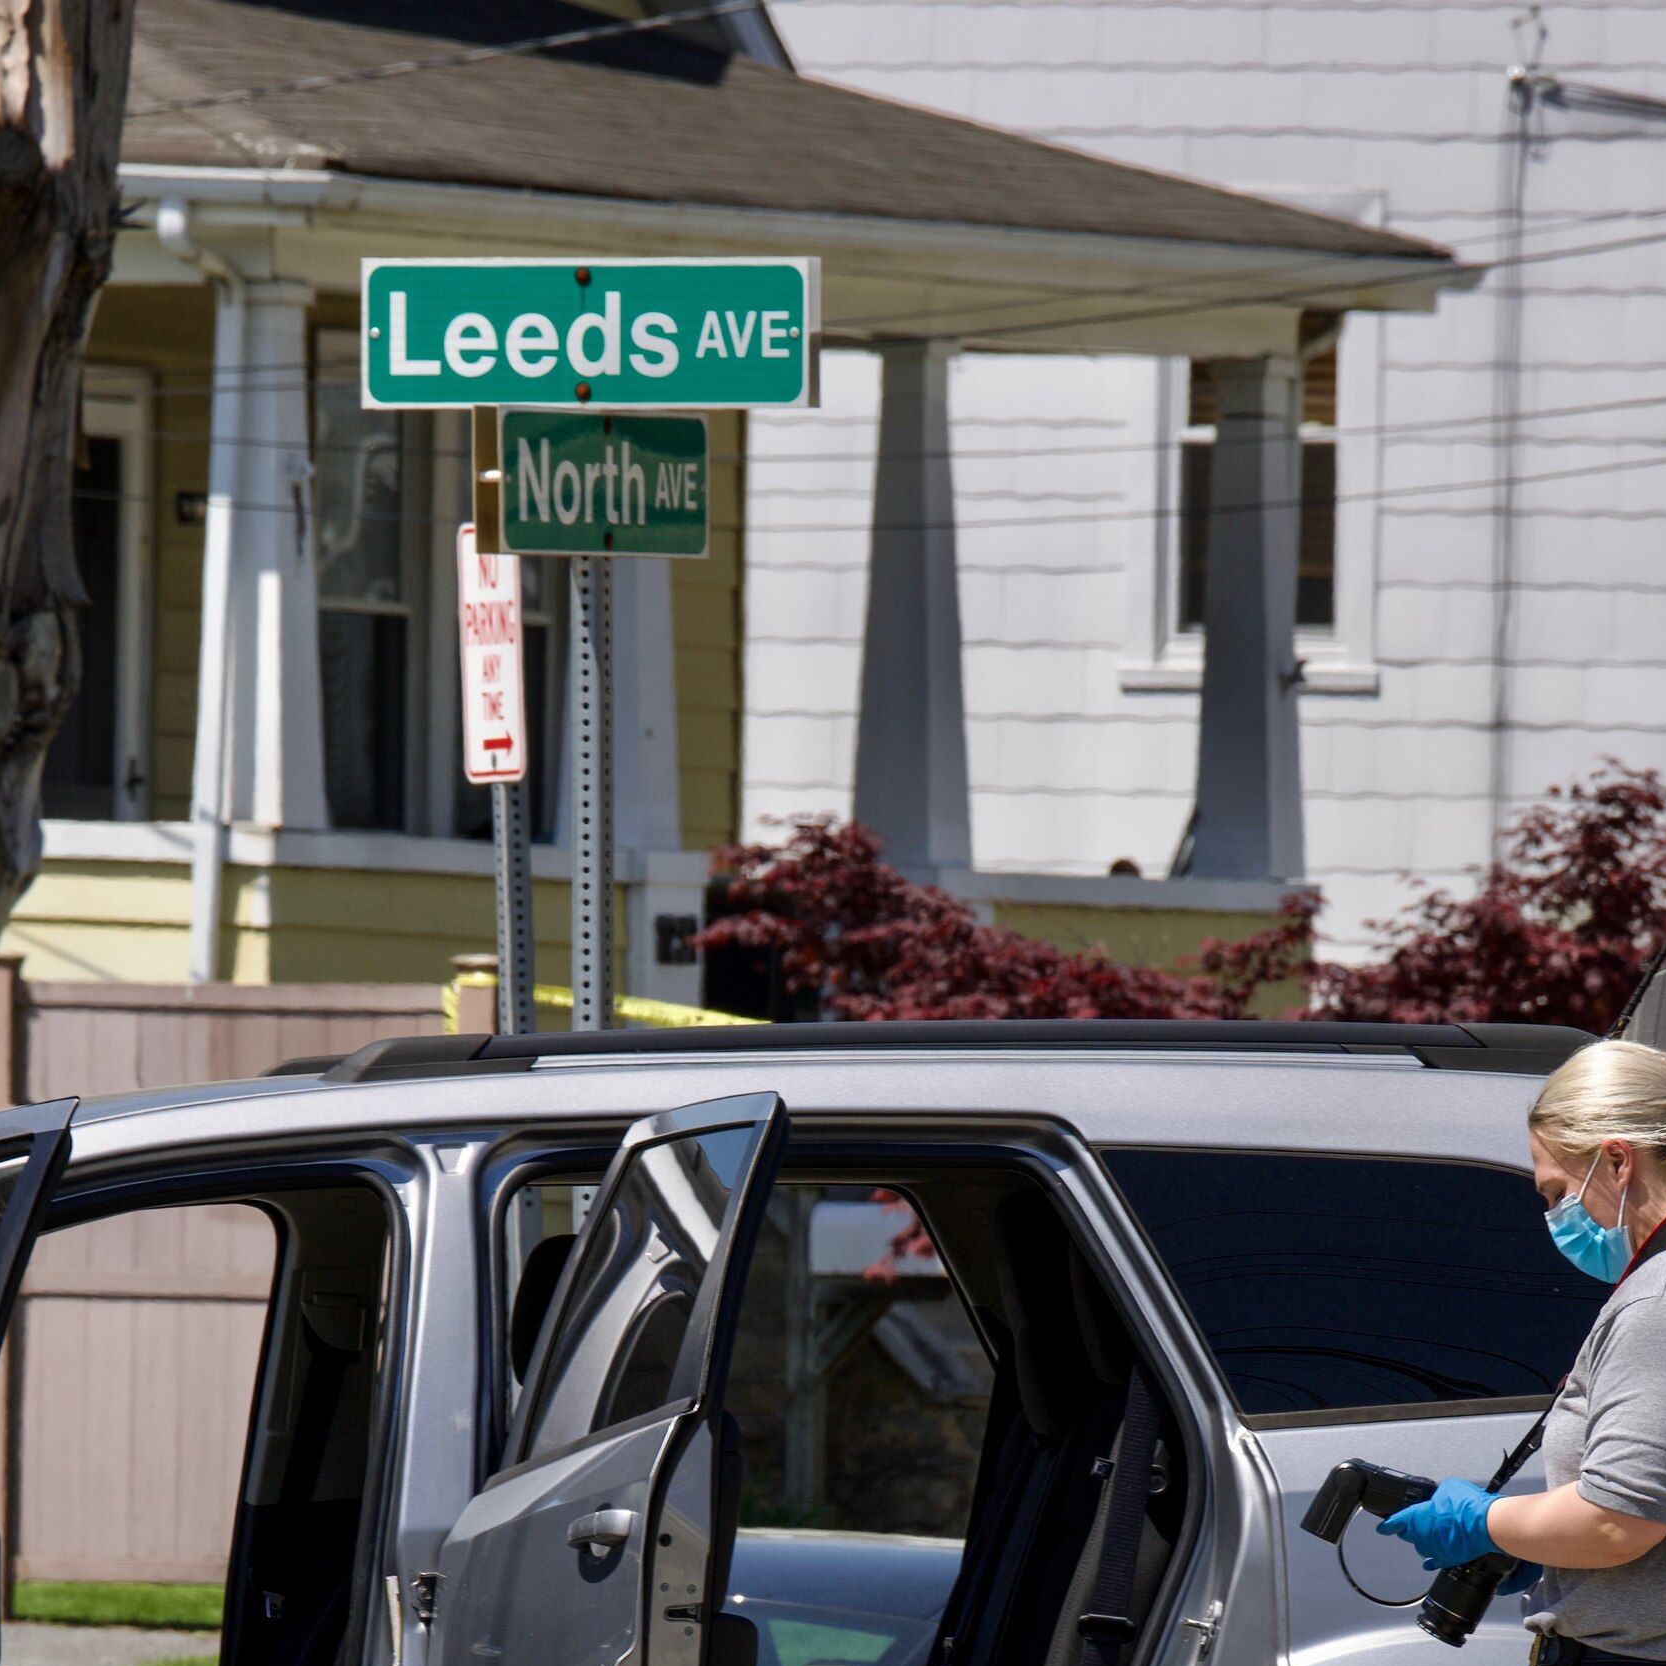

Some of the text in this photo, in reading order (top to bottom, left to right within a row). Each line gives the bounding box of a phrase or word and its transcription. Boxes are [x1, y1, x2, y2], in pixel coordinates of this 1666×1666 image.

[388, 290, 791, 378] Leeds AVE
[516, 436, 699, 526] North AVE
[464, 600, 516, 646] PARKING
[481, 653, 502, 685] ANY
[481, 691, 506, 722] TIME
